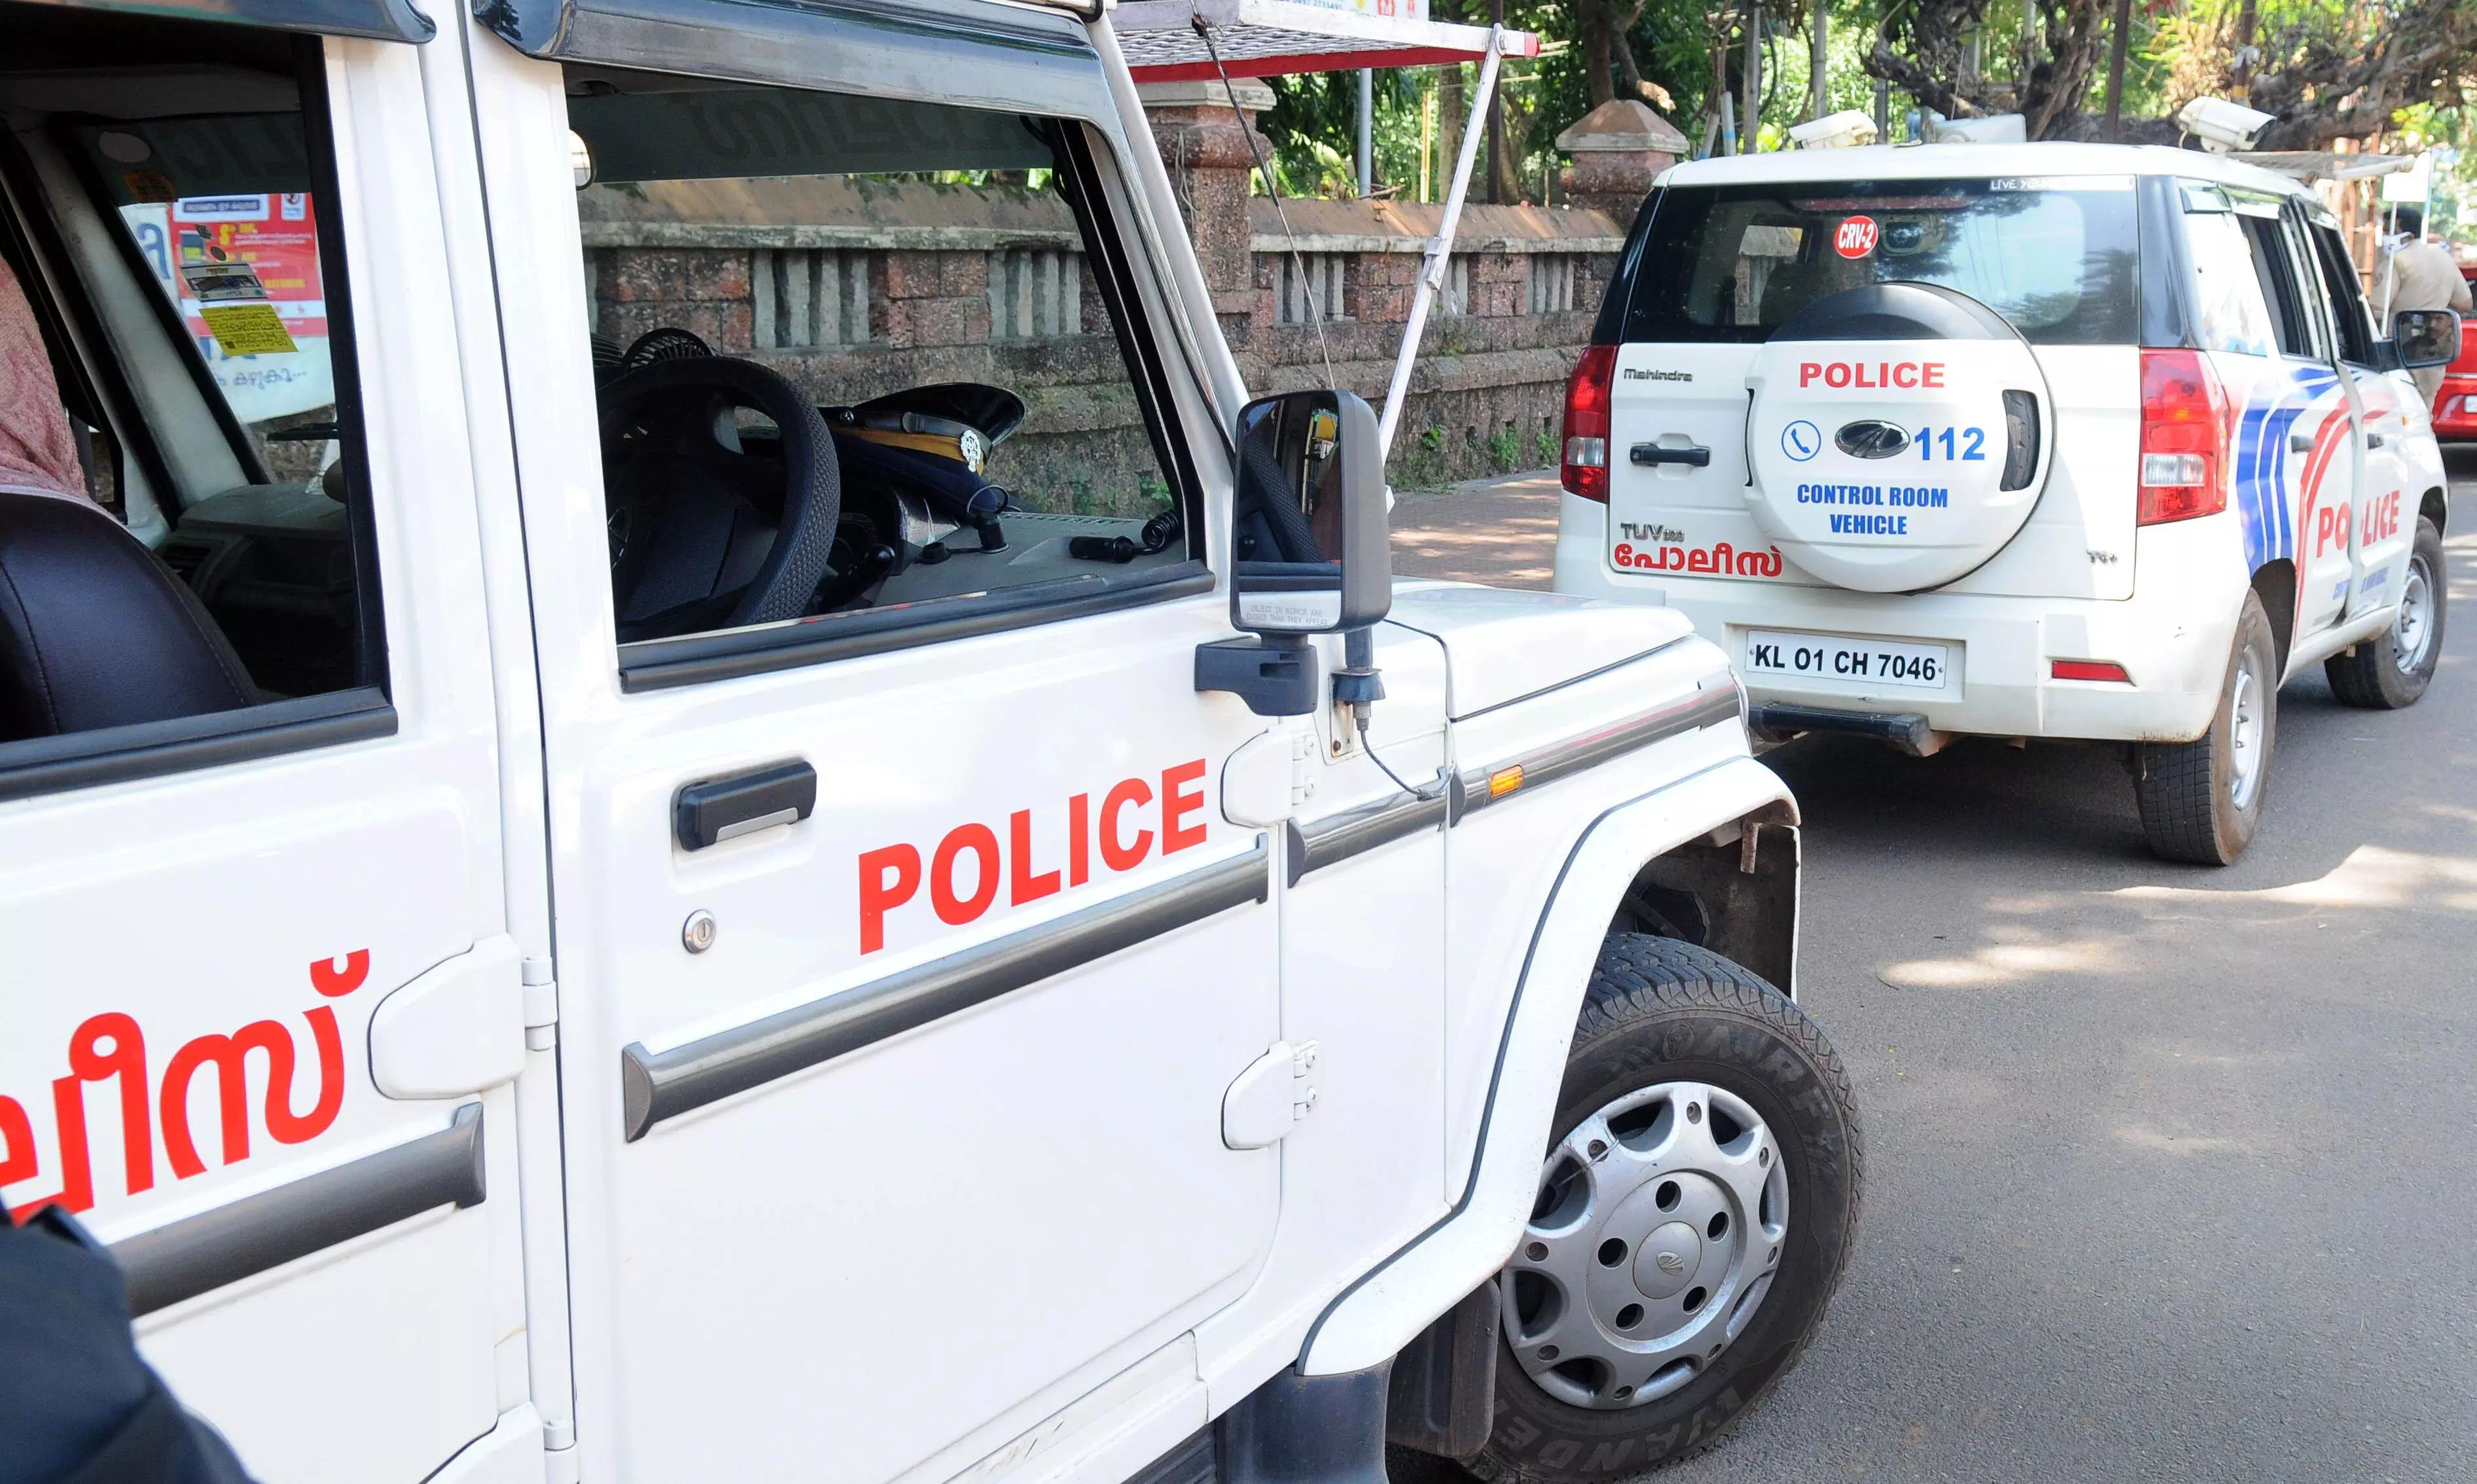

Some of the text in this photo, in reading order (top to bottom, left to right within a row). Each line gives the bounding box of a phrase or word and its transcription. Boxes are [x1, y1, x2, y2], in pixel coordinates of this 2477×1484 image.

[1991, 178, 2017, 190] LIVE
[1838, 223, 1875, 249] CRV-2
[1799, 362, 1946, 389] POLICE
[1914, 427, 1986, 461] 112
[1797, 484, 1948, 508] CONTROL ROOM
[1829, 514, 1908, 536] VEHICLE
[2317, 490, 2400, 558] POLICE
[1614, 542, 1783, 577] പോലീസ്
[1755, 644, 1786, 669] KL
[1834, 650, 1869, 676] CH
[1878, 654, 1936, 681] 7046
[858, 758, 1207, 957] POLICE
